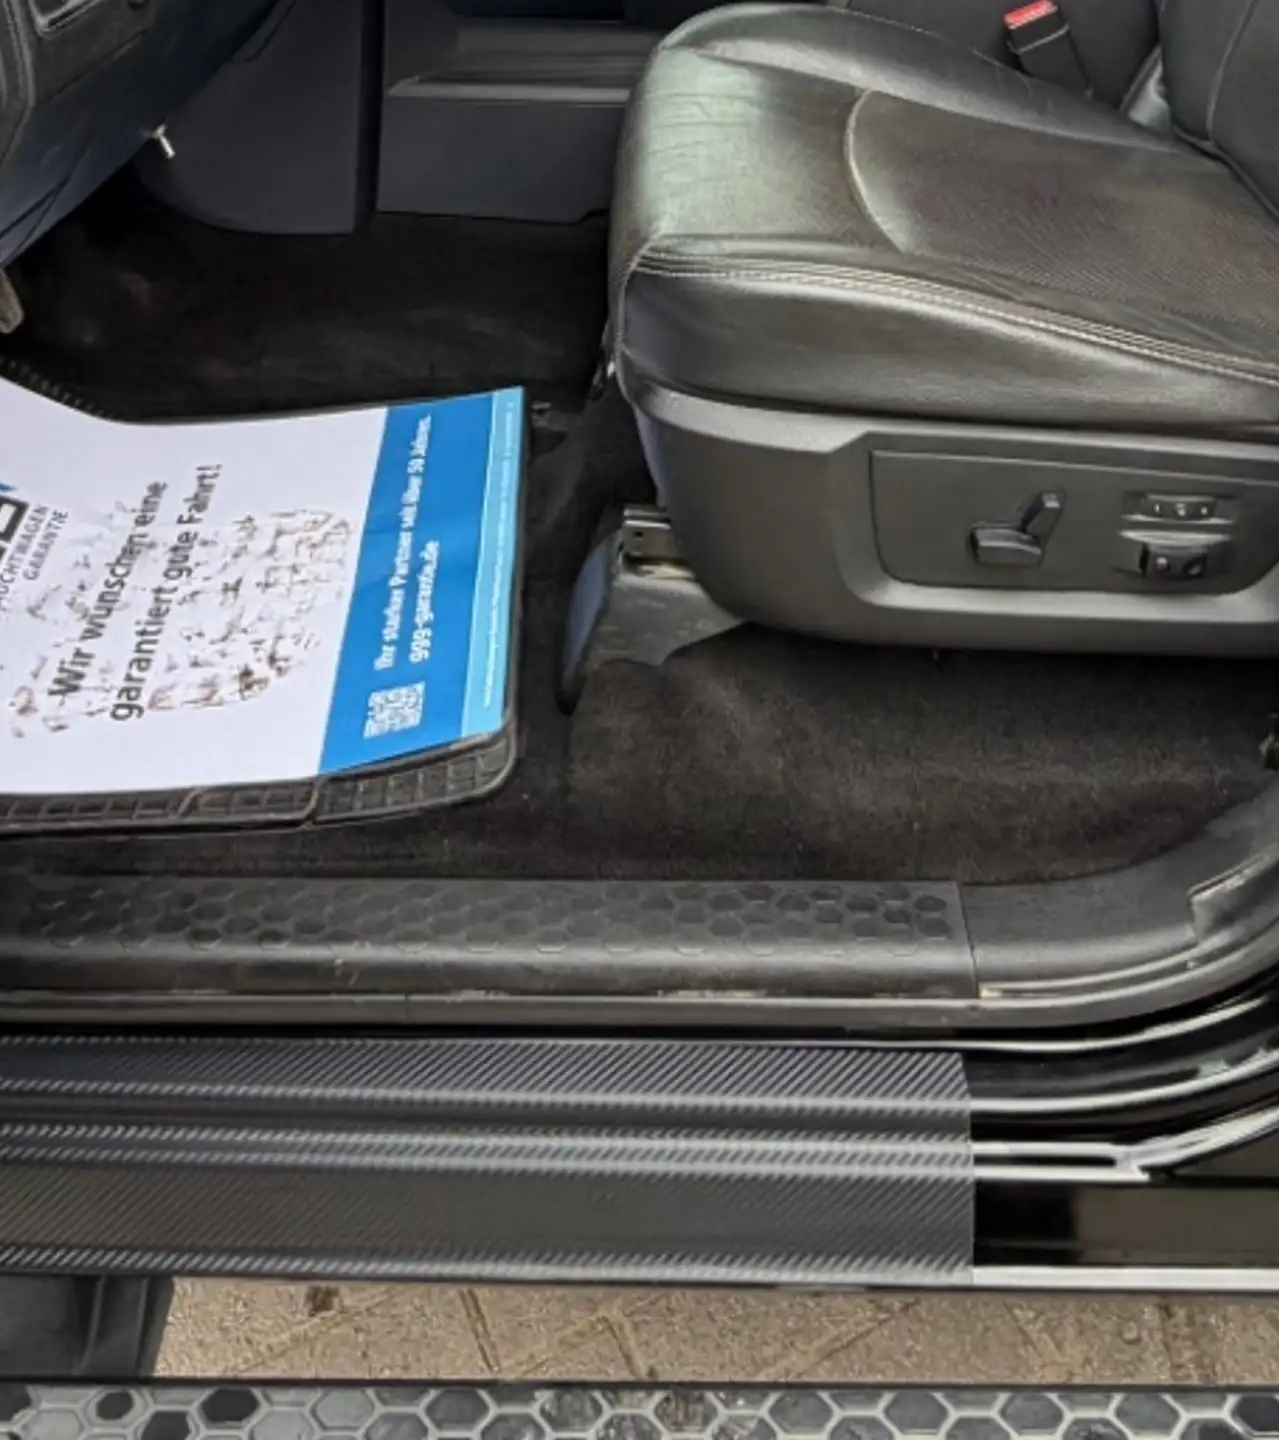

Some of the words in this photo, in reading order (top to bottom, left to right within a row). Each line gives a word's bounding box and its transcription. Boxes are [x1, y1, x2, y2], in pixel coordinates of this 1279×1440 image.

[176, 463, 223, 525] Fahrt!
[22, 509, 69, 581] GARANTIE
[162, 530, 200, 582] gute
[47, 647, 95, 697] Wir
[133, 480, 168, 527] eine
[109, 584, 179, 722] garantiert
